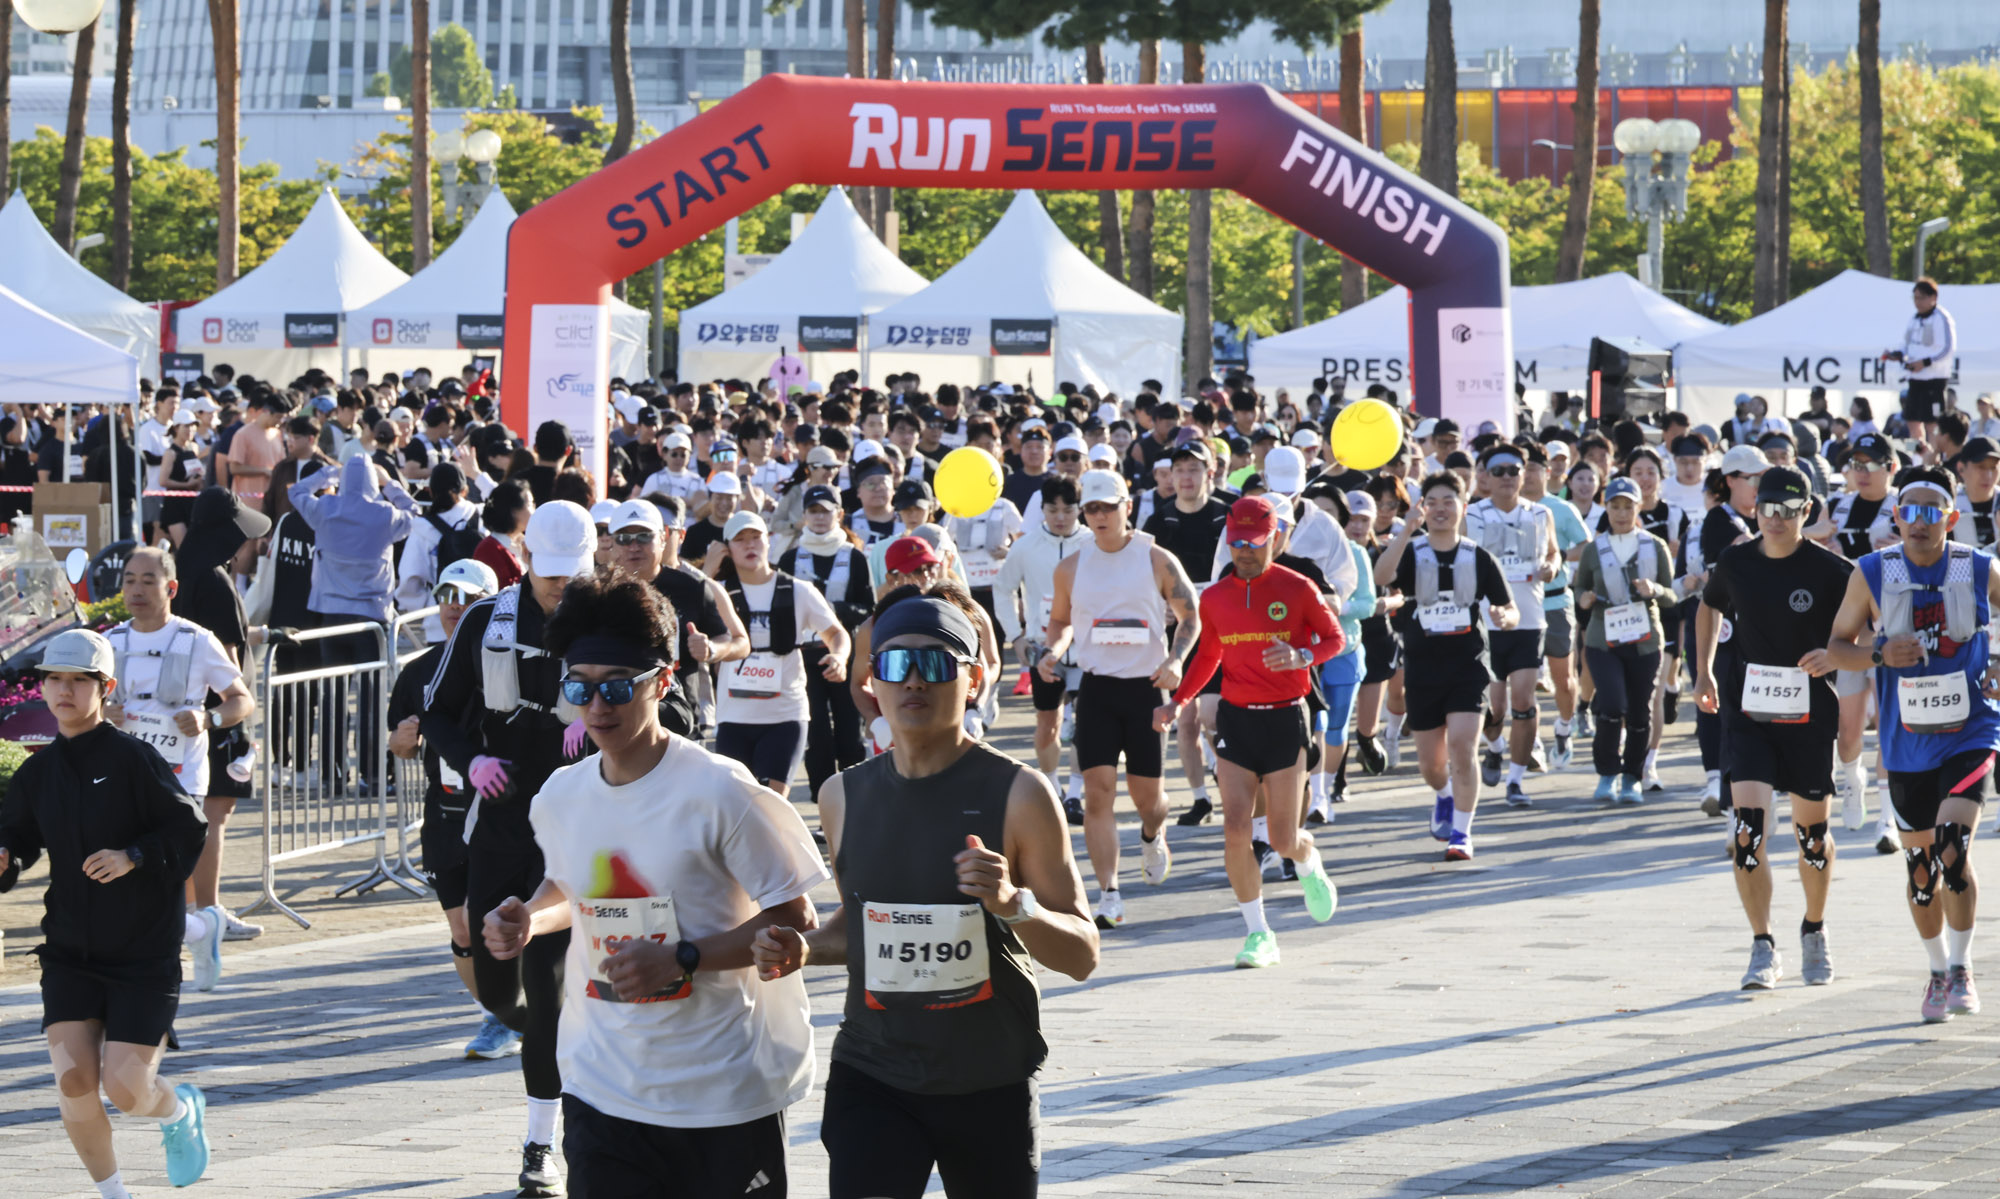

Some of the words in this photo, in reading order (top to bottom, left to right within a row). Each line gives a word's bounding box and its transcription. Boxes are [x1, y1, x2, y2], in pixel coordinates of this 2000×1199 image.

[1050, 103, 1073, 114] RUN
[1075, 103, 1095, 114] The
[1137, 103, 1159, 114] Feel
[1160, 103, 1180, 114] The
[1182, 102, 1218, 114] SENSE
[606, 123, 771, 249] START
[1279, 129, 1452, 257] FINISH
[1322, 358, 1410, 383] PRES
[1784, 356, 1841, 384] MC
[742, 666, 775, 678] 2060
[1750, 686, 1760, 694] M
[1764, 685, 1802, 698] 1557
[1907, 698, 1917, 707] M
[1921, 693, 1962, 709] 1559
[141, 732, 179, 748] 1173
[878, 943, 894, 960] M
[898, 940, 972, 963] 5190
